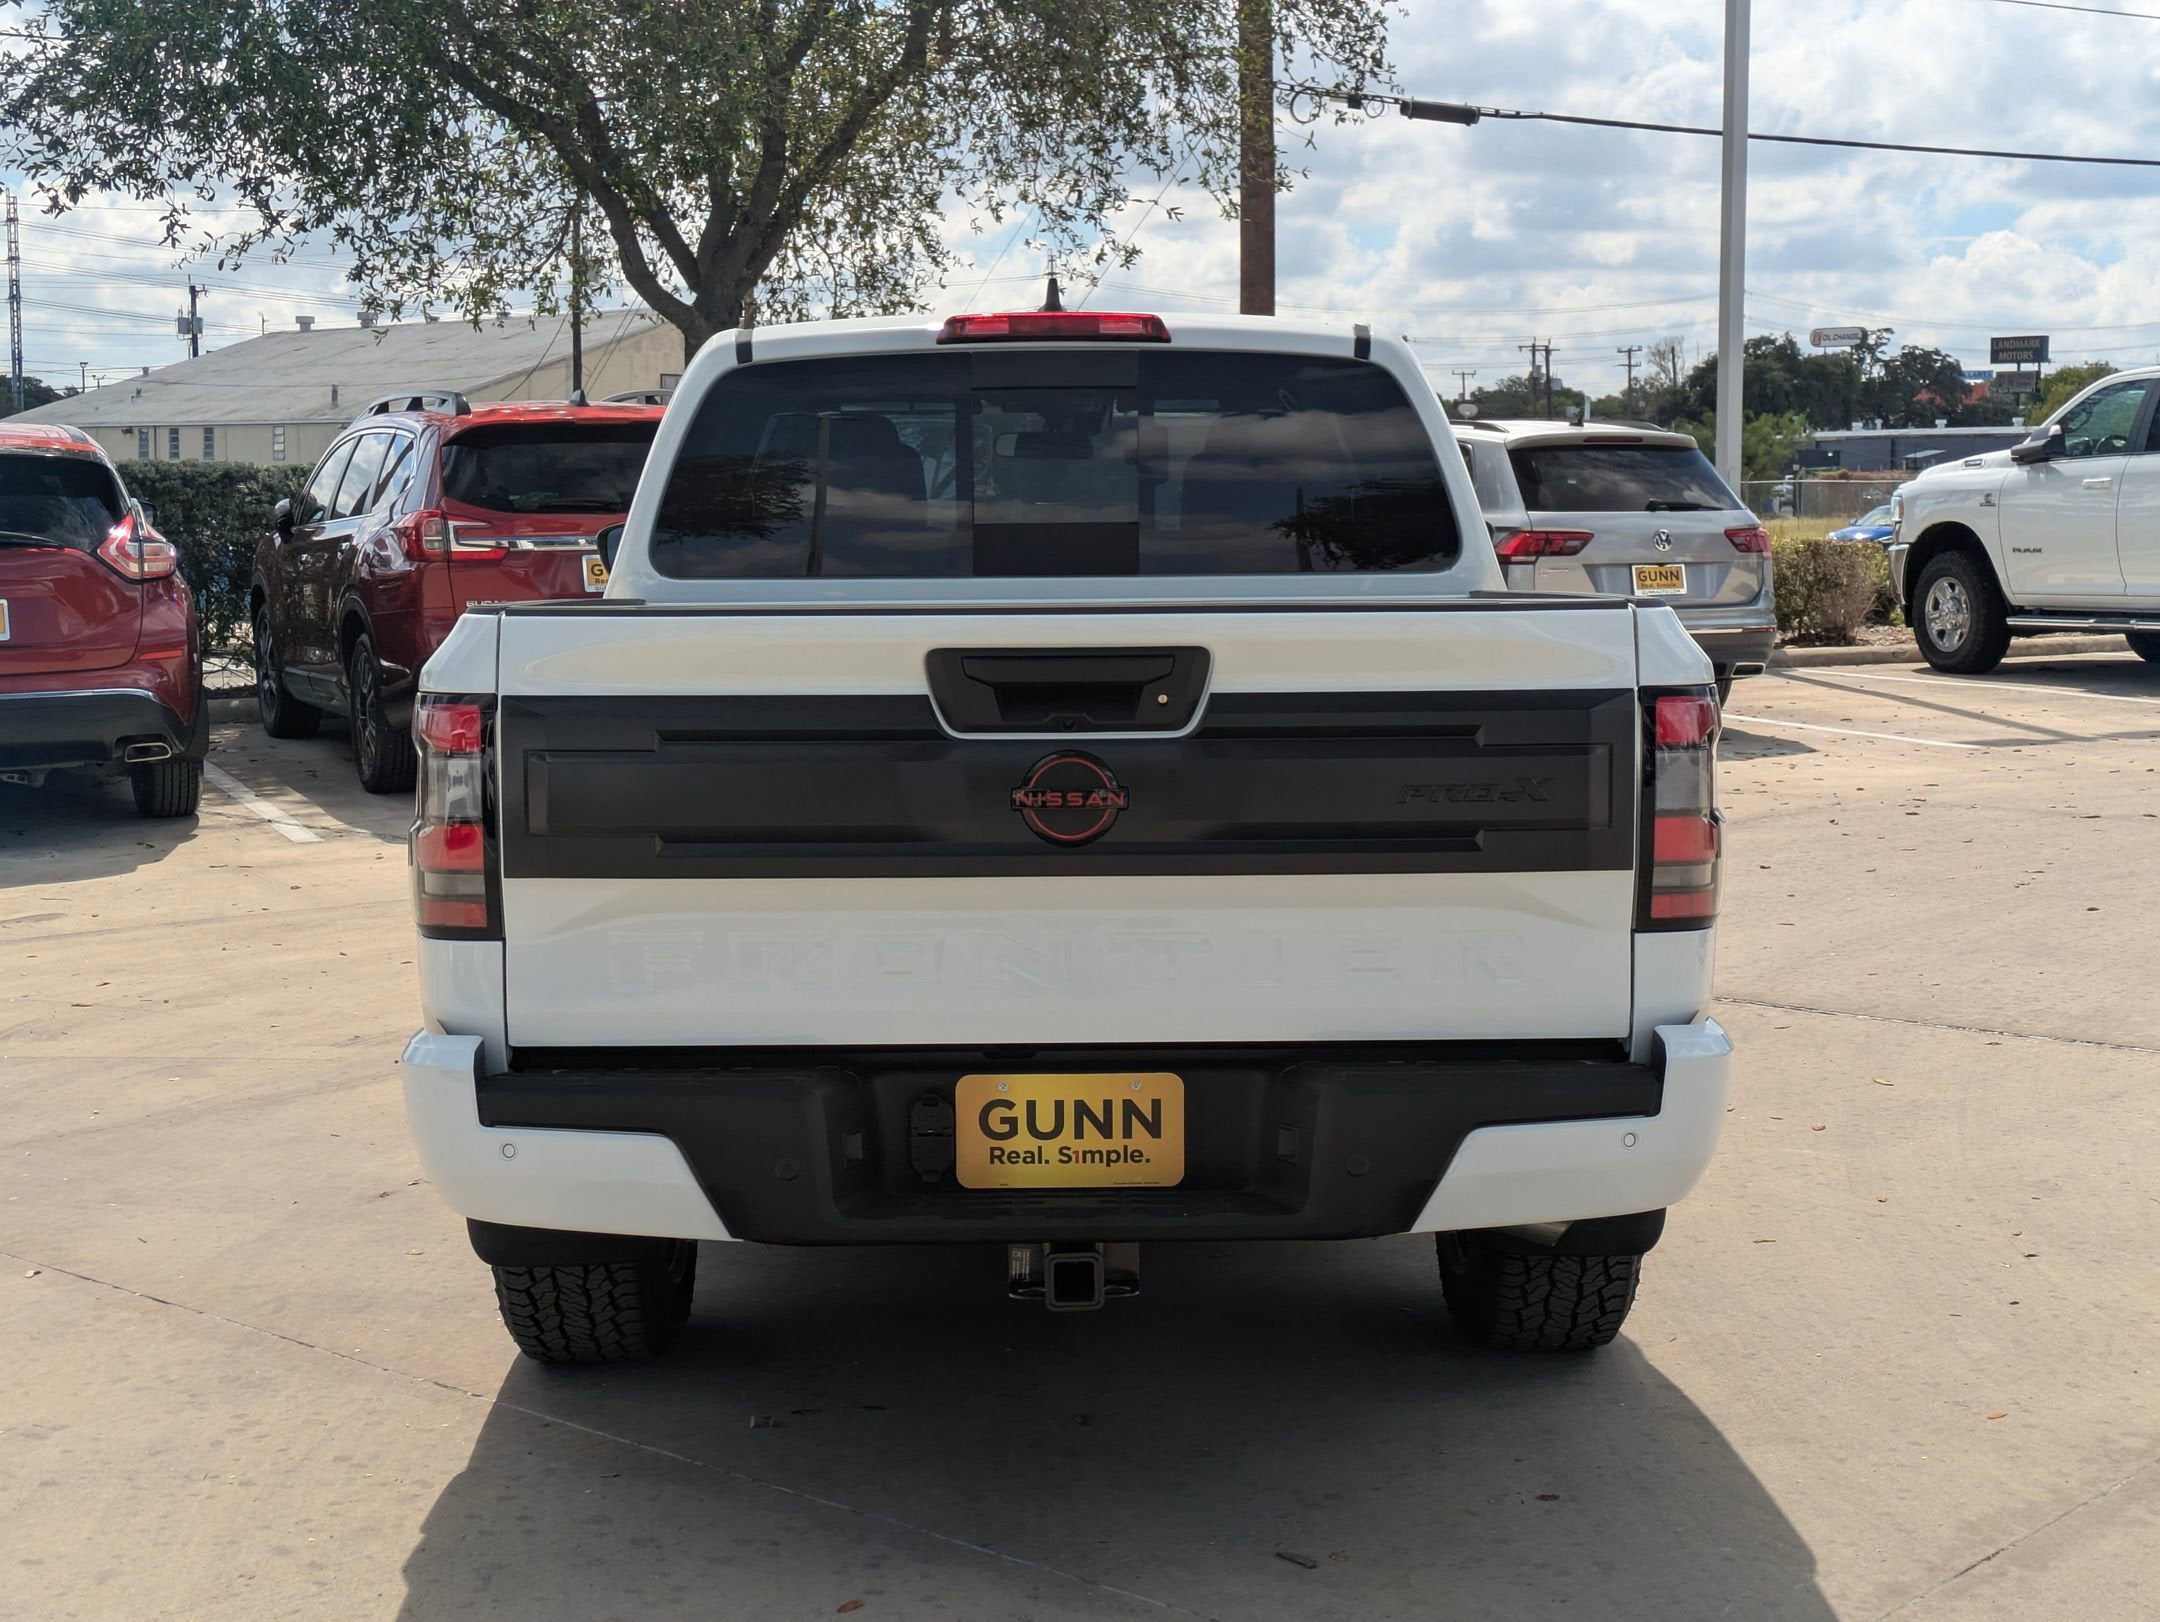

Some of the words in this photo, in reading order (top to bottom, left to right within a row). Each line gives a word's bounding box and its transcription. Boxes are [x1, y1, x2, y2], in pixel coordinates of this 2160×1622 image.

[1992, 338, 2041, 350] LANDMARK
[1999, 351, 2034, 361] MOTORS
[1638, 570, 1680, 582] GUNN
[1015, 791, 1128, 807] NISSAN
[607, 928, 1528, 994] FRONTIER
[979, 1098, 1162, 1141] GUNN
[989, 1146, 1050, 1165] Real.
